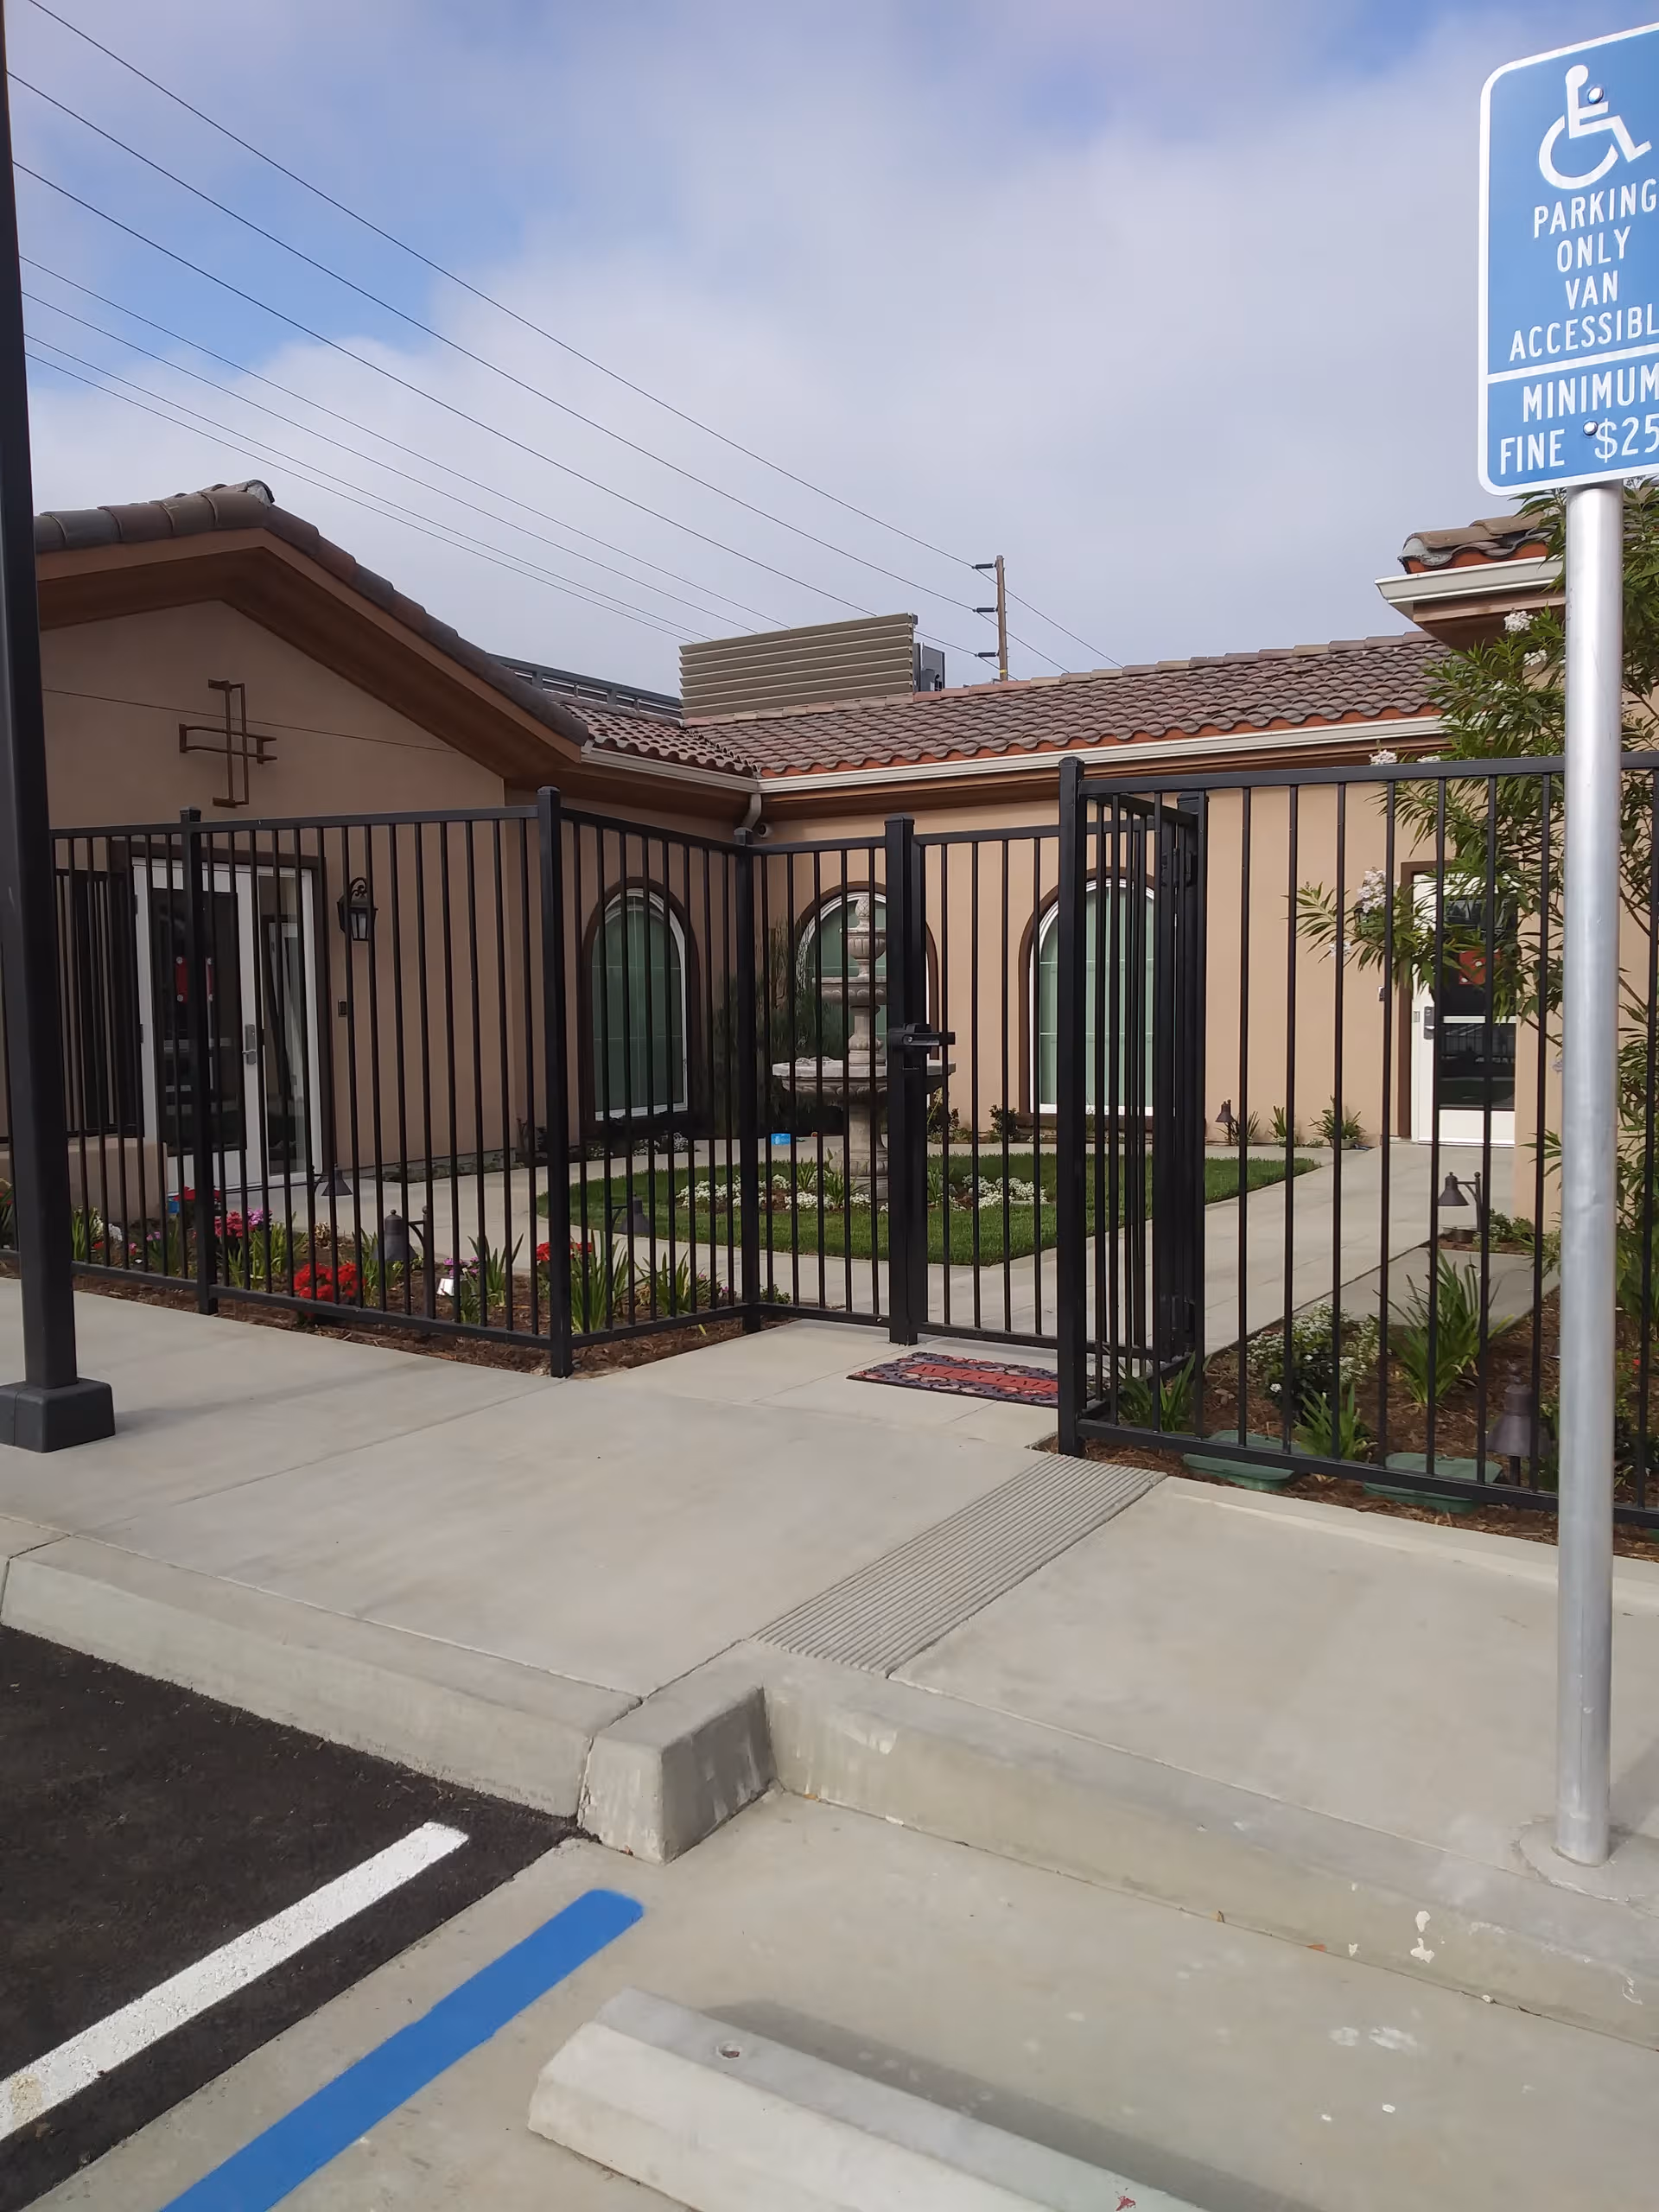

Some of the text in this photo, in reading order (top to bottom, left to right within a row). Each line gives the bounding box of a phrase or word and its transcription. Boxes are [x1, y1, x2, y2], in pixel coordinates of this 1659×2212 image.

[1534, 178, 1657, 238] PARKING
[1556, 226, 1631, 273] ONLY
[1565, 270, 1618, 311] VAN
[1510, 302, 1659, 361] ACCESSIBL
[1522, 361, 1659, 423] MINIMUM
[1500, 412, 1659, 475] FINE $25
